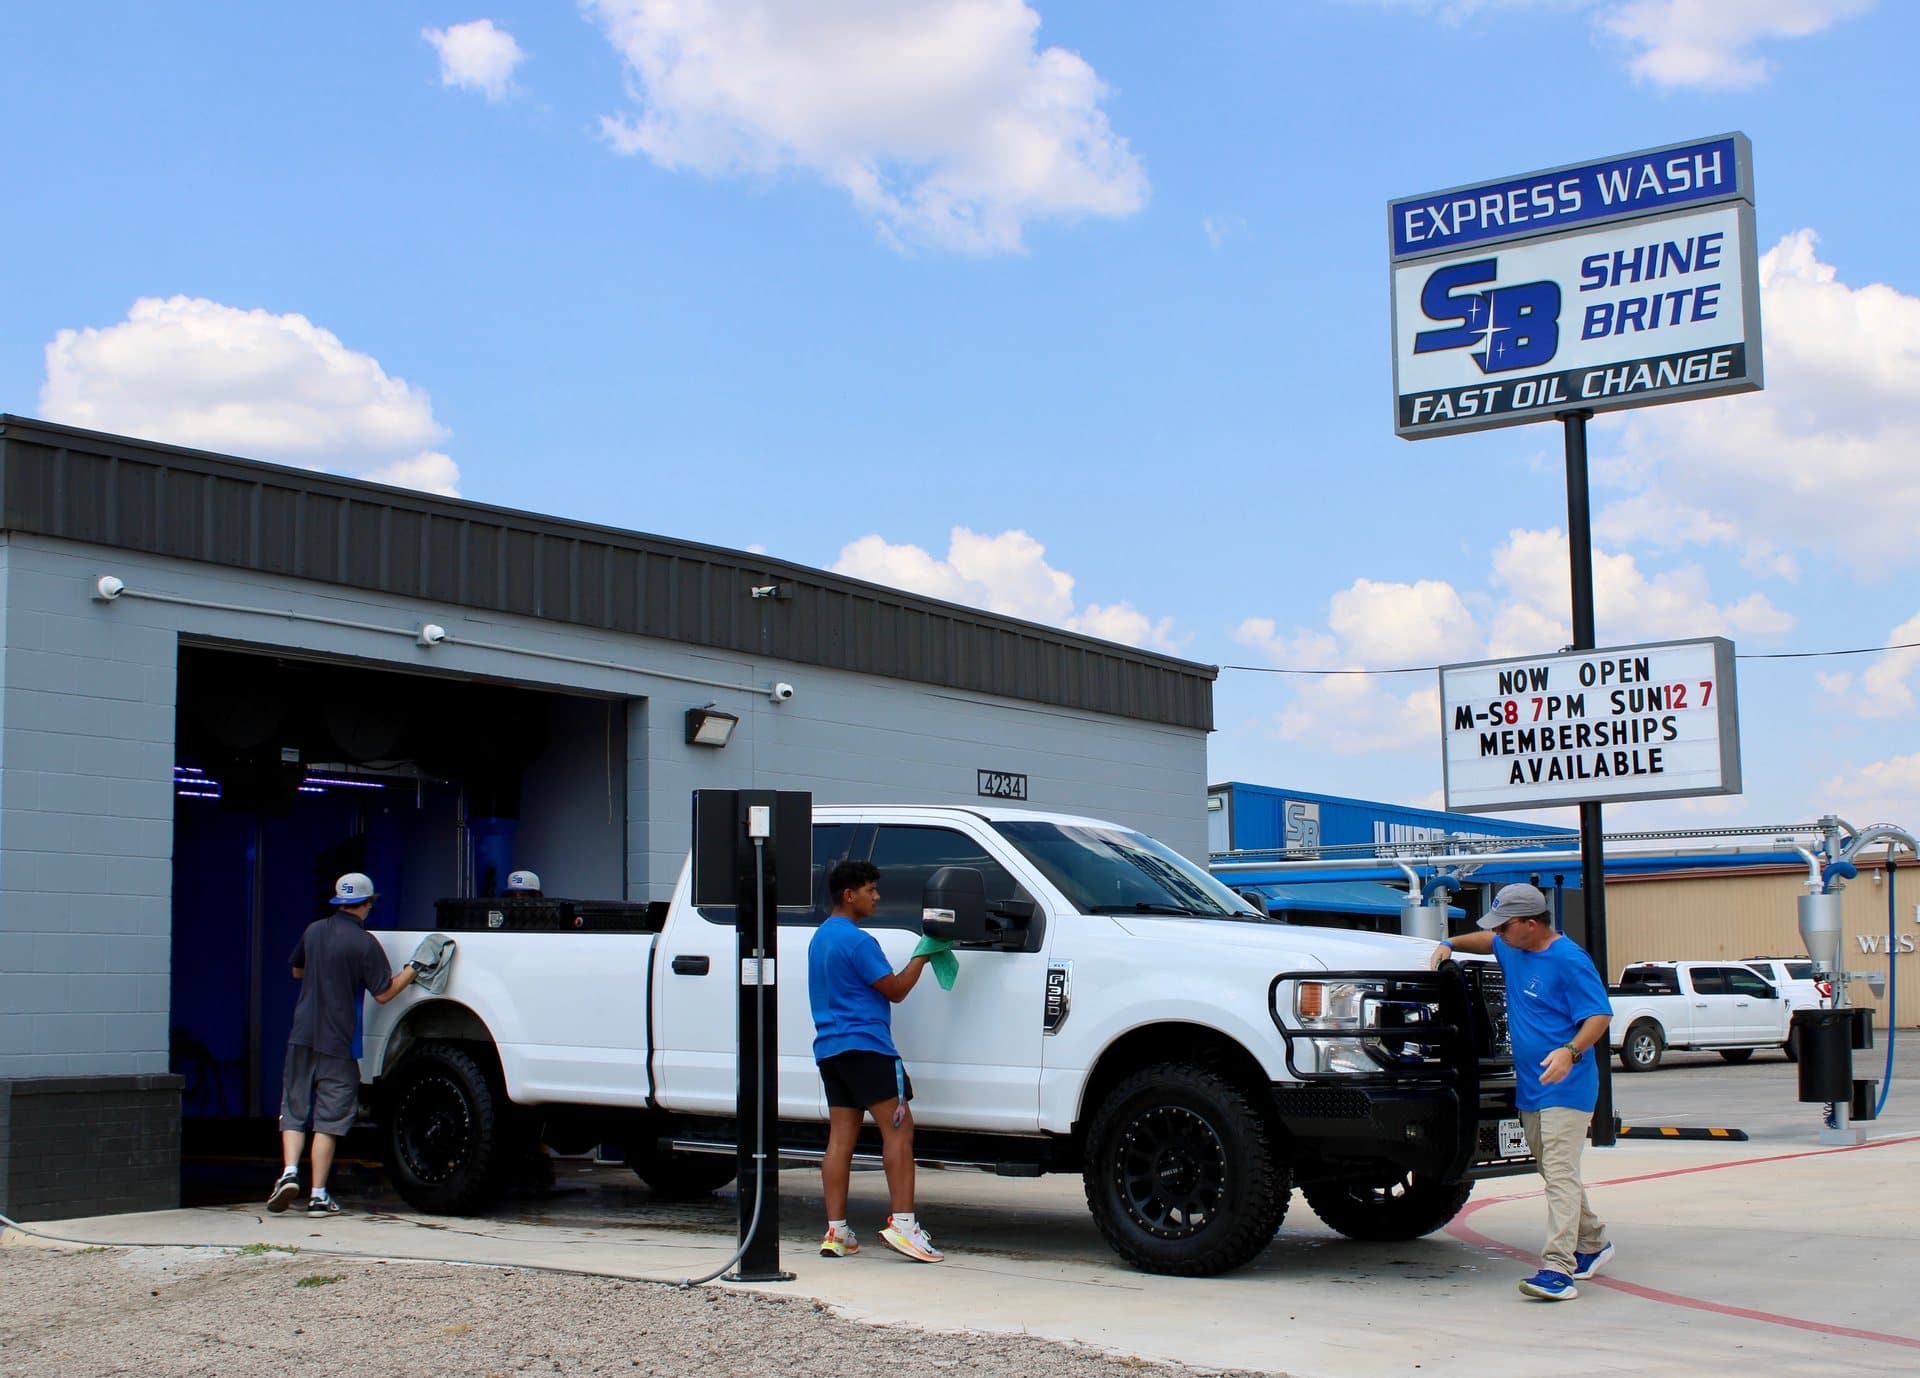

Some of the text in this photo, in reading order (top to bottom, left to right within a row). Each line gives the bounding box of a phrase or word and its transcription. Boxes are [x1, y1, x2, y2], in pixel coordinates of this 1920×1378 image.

[1404, 151, 1722, 243] EXPRESS WASH
[1580, 232, 1724, 293] SHINE
[1413, 256, 1562, 374] SB
[1580, 283, 1721, 341] BRITE
[1411, 350, 1733, 425] FAST OIL CHANGE
[1499, 657, 1650, 696] NOW OPEN
[1700, 681, 1713, 707] 7
[1480, 716, 1678, 757] MEMBERSHIPS
[984, 774, 1021, 798] 4234
[1509, 748, 1664, 784] AVAILABLE
